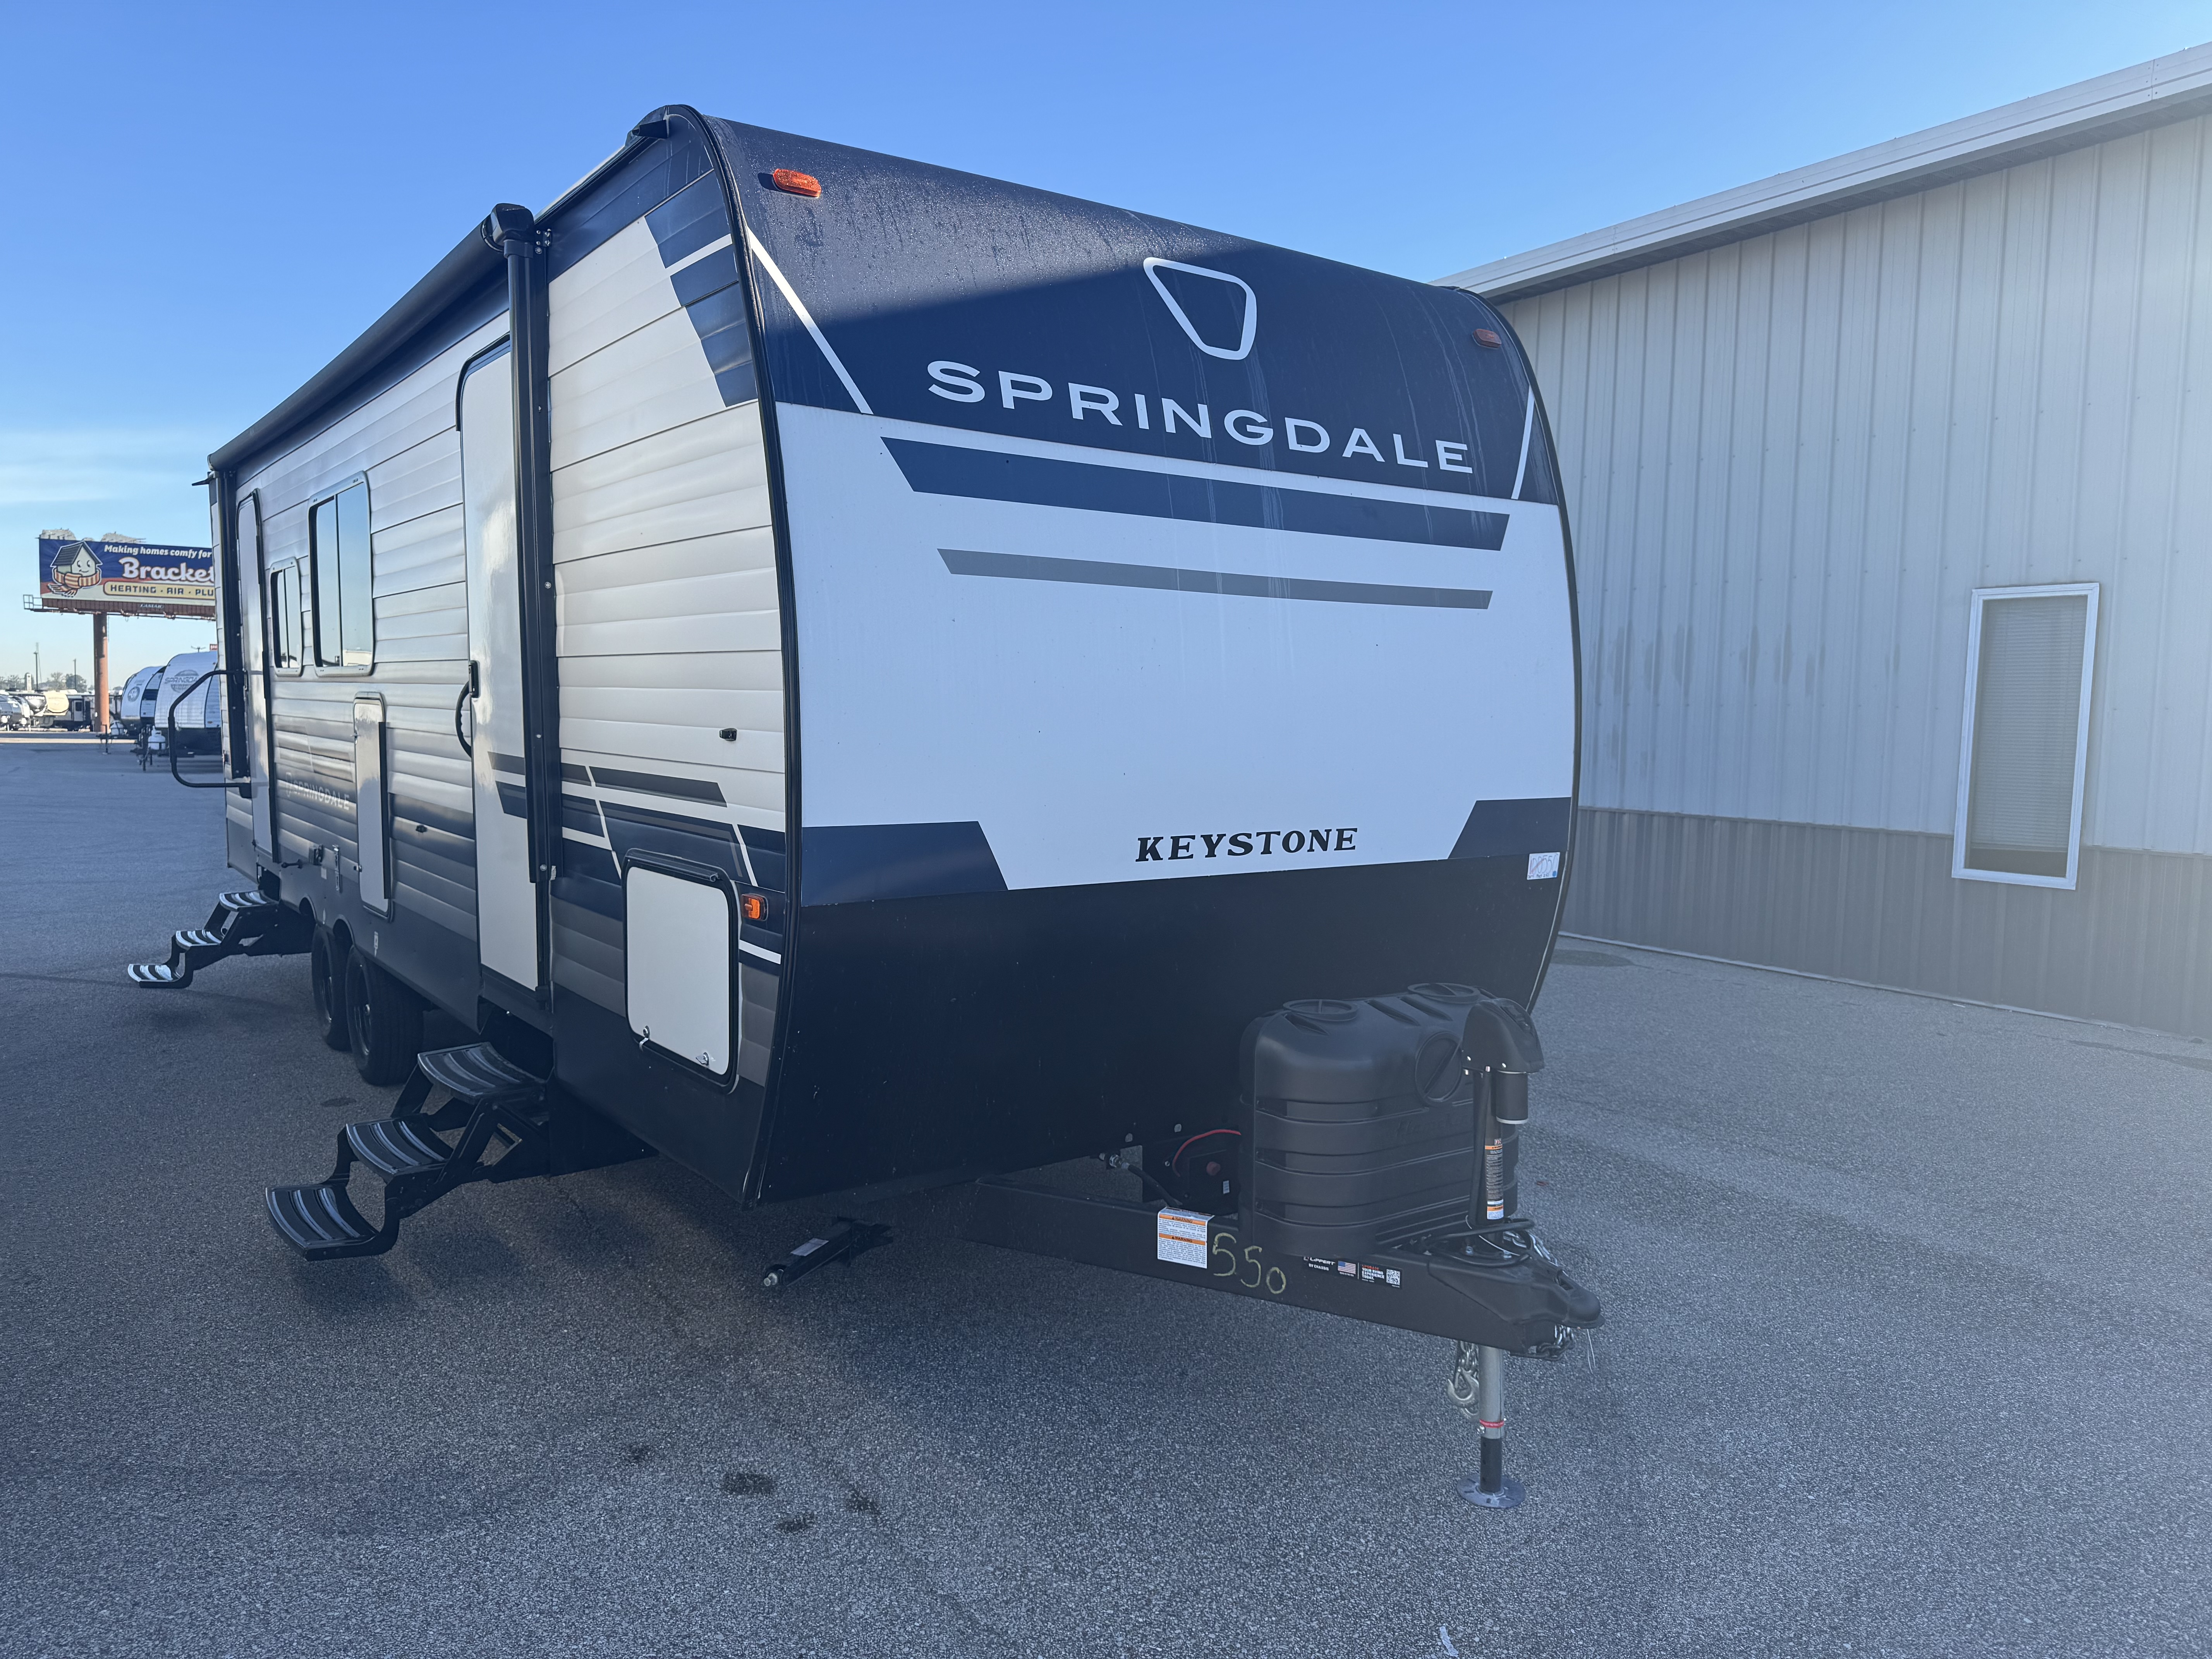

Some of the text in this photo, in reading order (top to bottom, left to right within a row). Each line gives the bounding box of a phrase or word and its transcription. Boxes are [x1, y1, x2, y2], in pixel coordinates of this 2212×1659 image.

[927, 360, 1473, 474] SPRINGDALE
[104, 544, 212, 559] Making homes comfy for
[110, 584, 156, 593] HEATING
[294, 780, 350, 811] SPRINGDALE
[1135, 828, 1358, 862] KEYSTONE
[1212, 1232, 1286, 1294] 550
